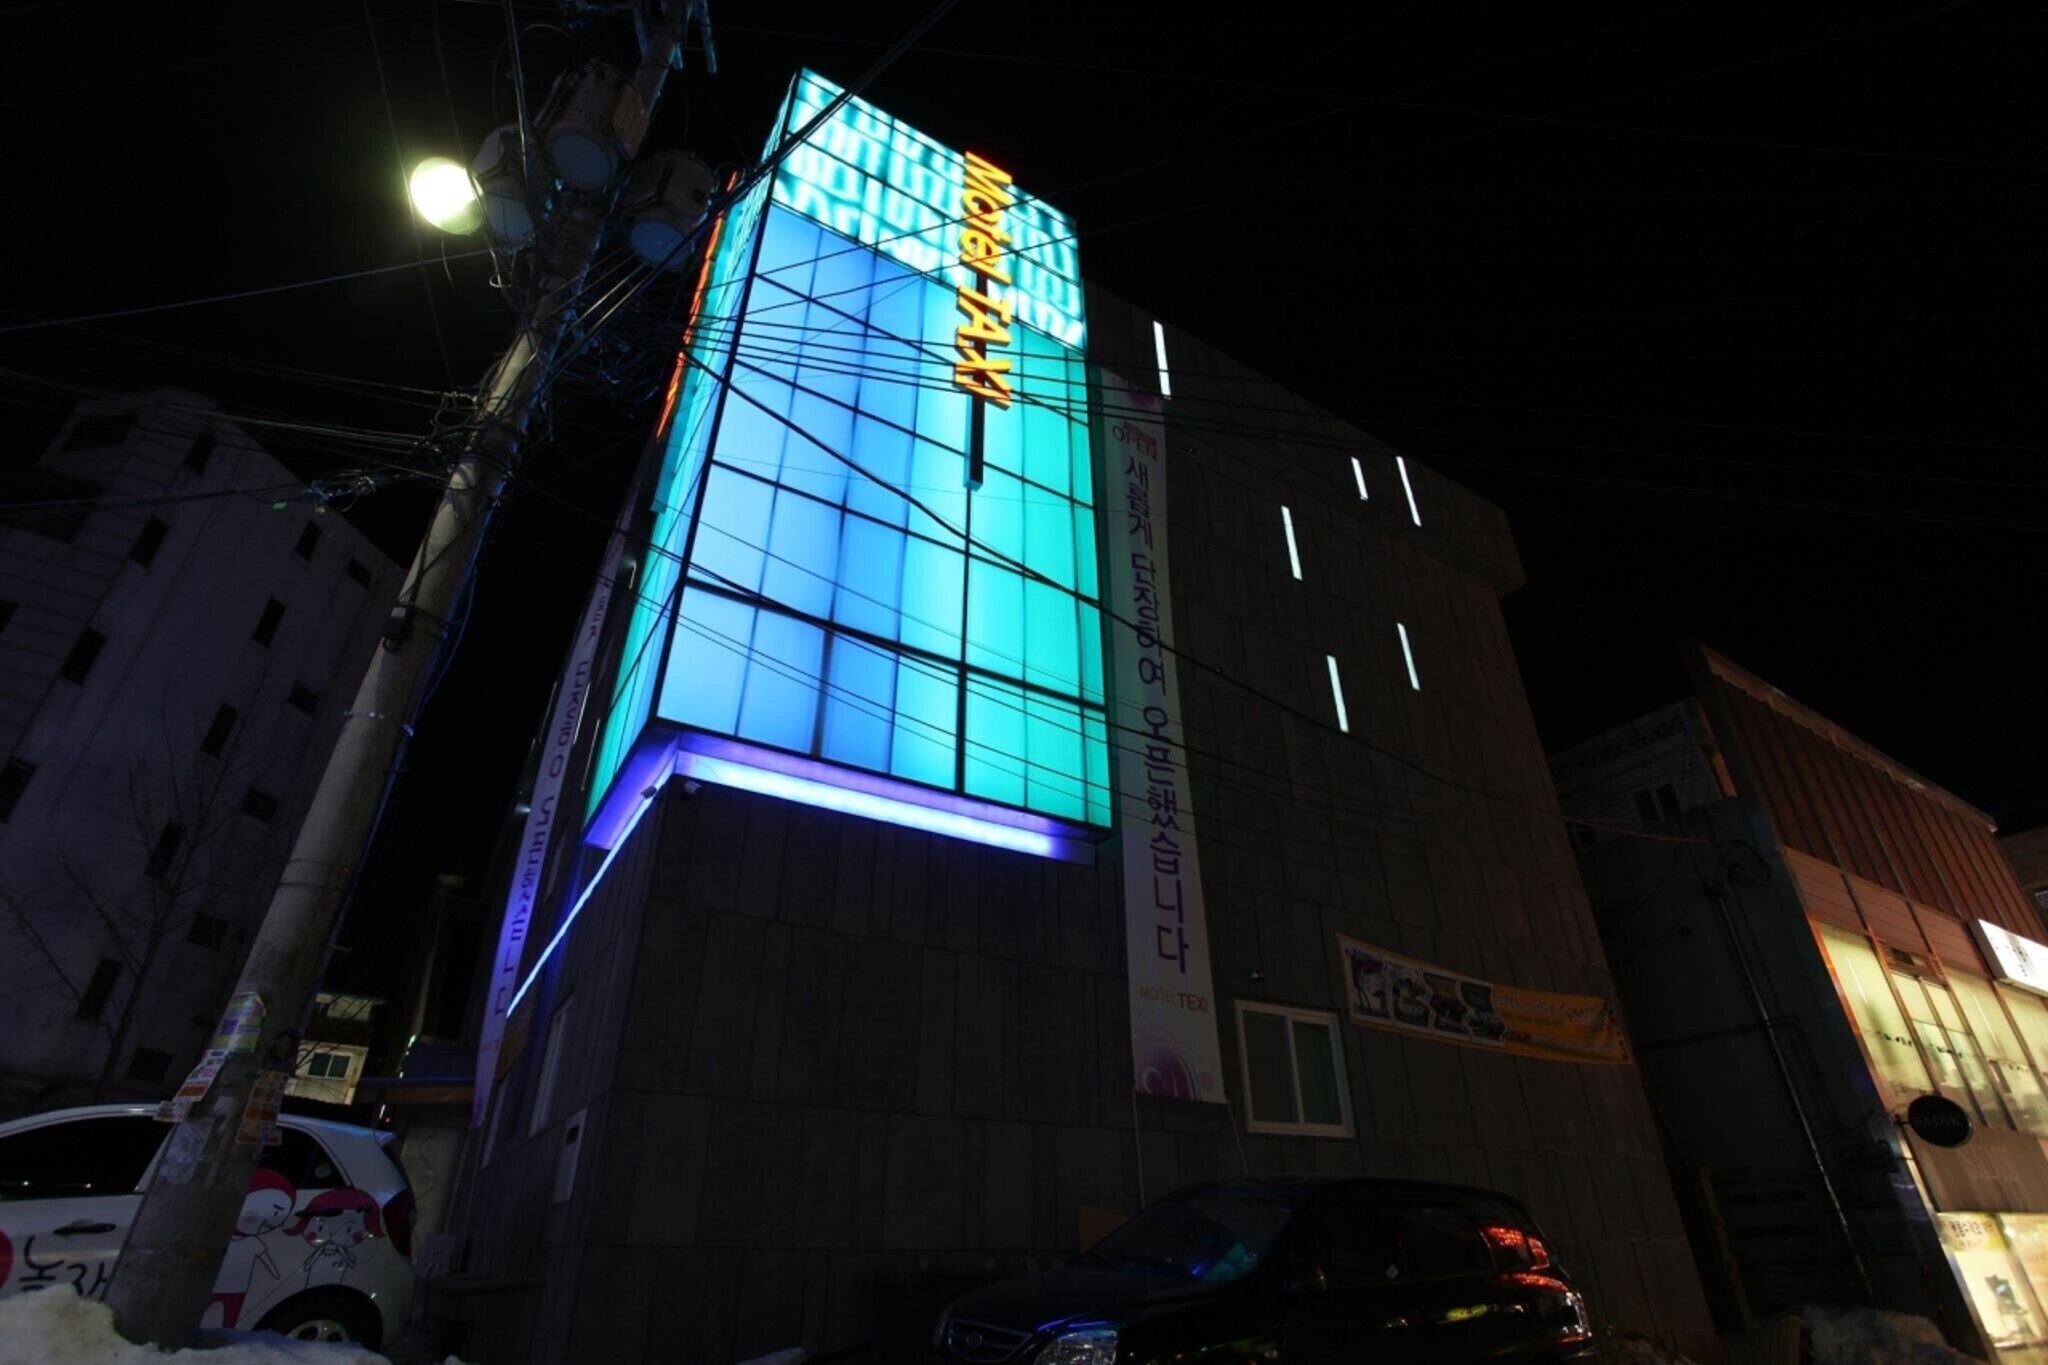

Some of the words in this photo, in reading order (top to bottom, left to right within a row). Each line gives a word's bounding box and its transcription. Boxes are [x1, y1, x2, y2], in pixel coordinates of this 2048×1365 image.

[960, 150, 1013, 286] Motel
[1124, 455, 1154, 551] 새롭게
[1130, 552, 1167, 697] 단장하여
[1142, 705, 1190, 974] 오픈했습니다
